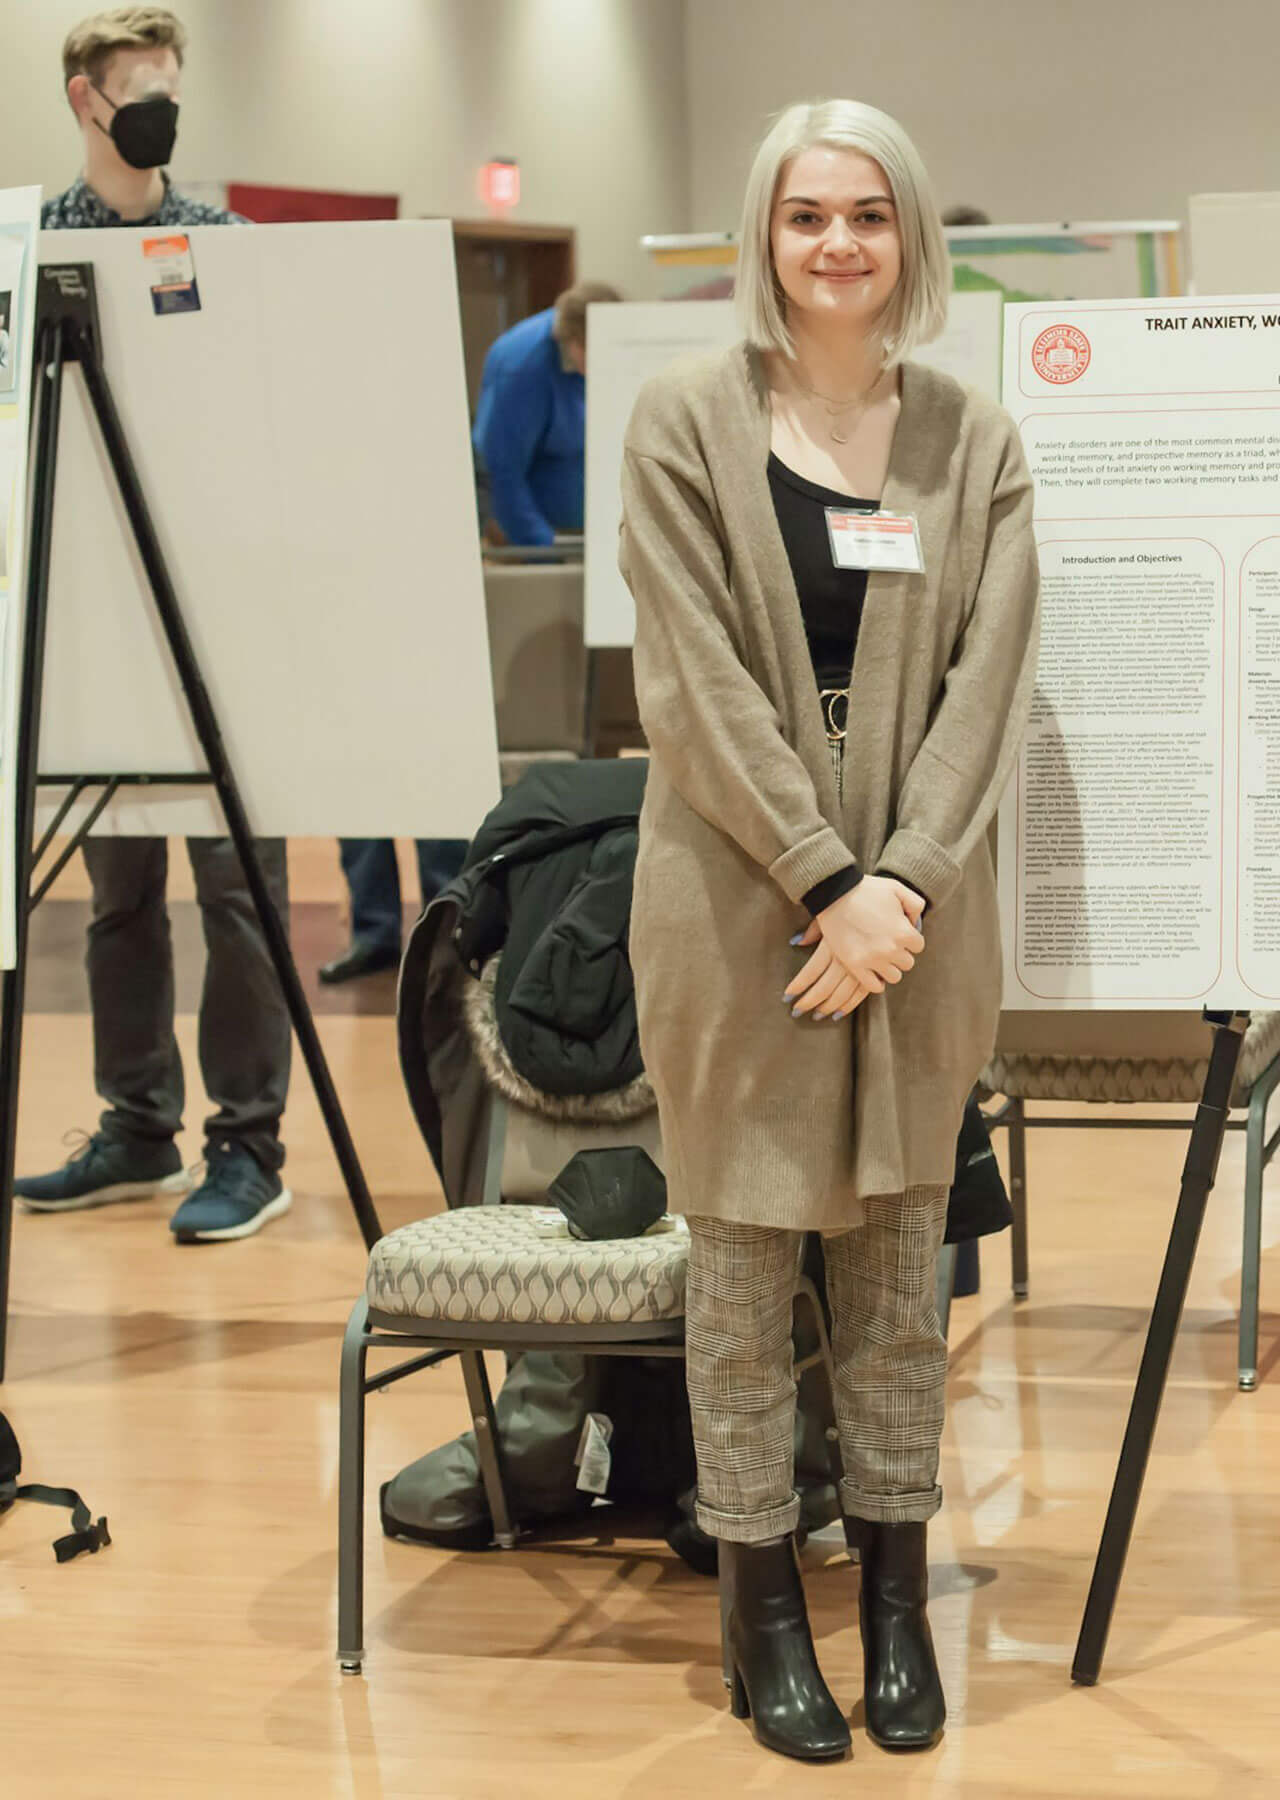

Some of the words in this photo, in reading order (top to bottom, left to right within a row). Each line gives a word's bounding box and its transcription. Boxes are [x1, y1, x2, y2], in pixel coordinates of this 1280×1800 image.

[1145, 316, 1188, 331] TRAIT
[1192, 314, 1256, 332] ANXIETY,
[1035, 439, 1066, 452] Anxiety
[1069, 438, 1107, 449] disorders
[1109, 440, 1123, 448] are
[1155, 436, 1169, 447] the
[1171, 437, 1192, 446] most
[1195, 438, 1233, 446] common
[1235, 434, 1265, 445] mental
[1041, 452, 1075, 464] working
[1117, 450, 1133, 460] and
[1135, 450, 1184, 462] prospective
[1187, 451, 1222, 461] memory
[1031, 464, 1068, 474] elevated
[1070, 463, 1094, 474] levels
[1107, 464, 1124, 473] trait
[1127, 463, 1158, 475] anxiety
[1173, 461, 1208, 474] working
[1209, 463, 1246, 473] memory
[1248, 459, 1264, 470] and
[1062, 553, 1116, 564] Introduction
[1119, 553, 1135, 563] and
[1137, 552, 1182, 565] Objectives
